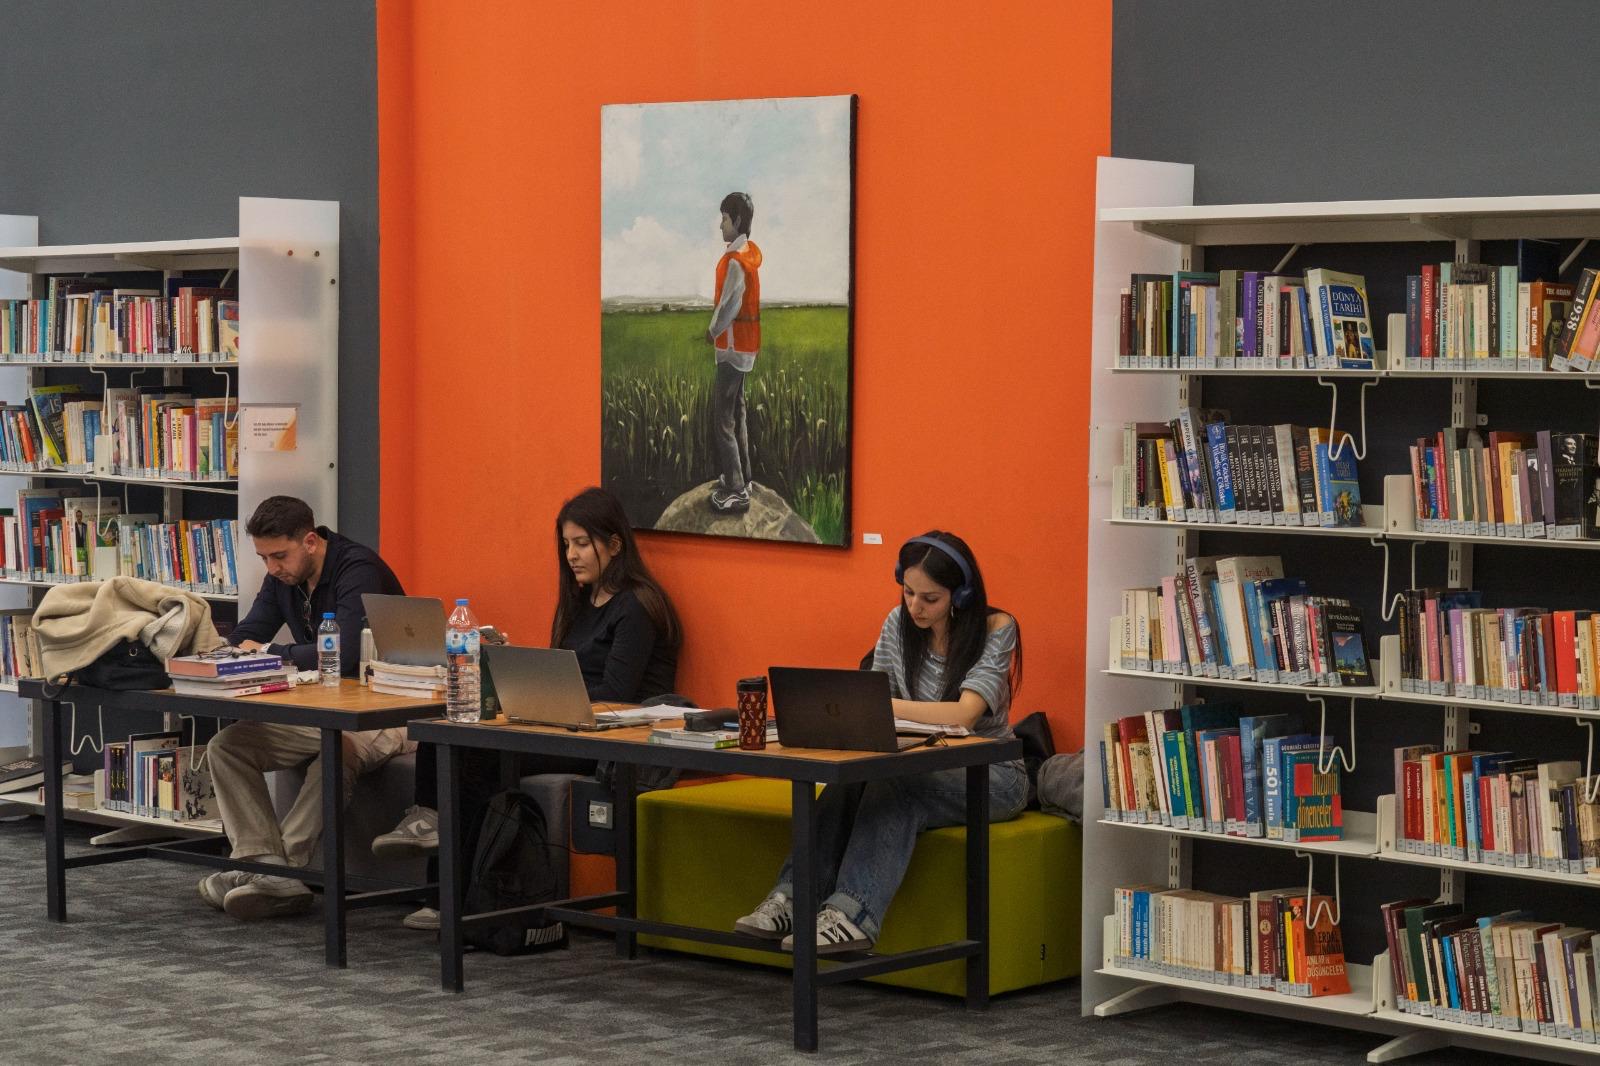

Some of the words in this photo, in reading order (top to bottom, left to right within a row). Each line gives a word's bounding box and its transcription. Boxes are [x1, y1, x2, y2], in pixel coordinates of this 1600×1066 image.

[1332, 291, 1361, 303] DÜNYA
[1334, 302, 1362, 312] TARİHİ
[1567, 297, 1585, 331] 1938
[1187, 565, 1199, 599] DÜNYA
[1266, 767, 1278, 795] 501
[524, 921, 563, 946] PUMA
